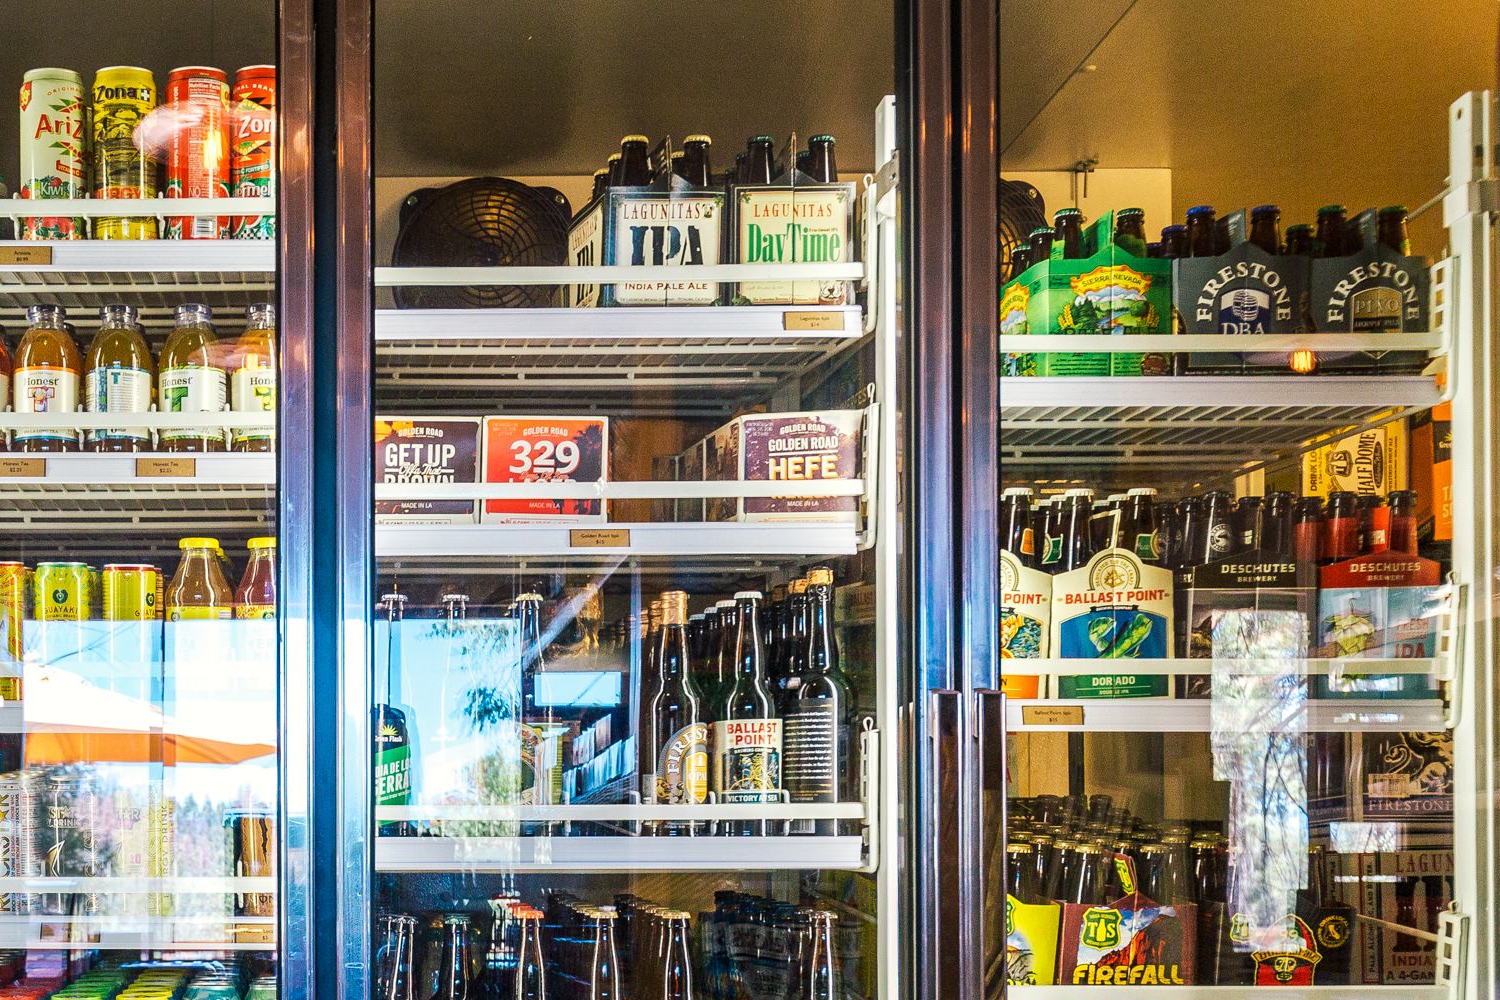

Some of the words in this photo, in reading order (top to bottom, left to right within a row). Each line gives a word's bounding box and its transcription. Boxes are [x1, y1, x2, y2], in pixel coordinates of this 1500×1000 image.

[623, 202, 701, 220] LAGUNITAS
[753, 203, 833, 218] LAGUNITAS
[629, 225, 705, 266] IPA
[747, 222, 841, 264] DayTime
[624, 282, 653, 291] INDIA
[656, 282, 686, 291] PALE
[690, 281, 709, 291] ALE
[1082, 275, 1110, 286] SIERRA
[1112, 273, 1142, 286] NEVADA
[1196, 261, 1292, 323] FIRESTONE
[1327, 261, 1420, 323] FIRESTONE
[1355, 300, 1400, 313] PIVO
[1221, 322, 1266, 335] DBA
[25, 377, 60, 388] Honest
[161, 375, 194, 387] Honest
[398, 427, 425, 437] GOLDEN
[426, 427, 444, 437] ROAD
[523, 427, 549, 437] GOLDEN
[550, 427, 569, 437] ROAD
[780, 424, 806, 435] GOLDEN
[807, 423, 826, 433] ROAD
[768, 437, 809, 452] GOLDEN
[810, 436, 839, 449] ROAD
[1359, 432, 1377, 465] DOME
[385, 443, 423, 467] GET
[432, 444, 456, 467] UP
[509, 440, 581, 474] 329
[769, 455, 840, 481] HEFE
[1357, 465, 1373, 497] HALF
[1221, 563, 1296, 575] DESCHUTES
[1350, 562, 1421, 573] DESCHUTES
[1237, 575, 1277, 583] BREWERY
[1367, 574, 1404, 582] BREWERY
[1003, 593, 1043, 605] POINT
[1065, 592, 1123, 605] BALLAST
[1126, 589, 1166, 602] POINT
[44, 606, 79, 615] GUAYAKI
[1395, 643, 1425, 658] IPA
[1092, 676, 1136, 687] DORADO
[726, 722, 778, 734] BALLAST
[734, 734, 773, 746] POINT
[1368, 799, 1453, 812] FIRESTONE
[1393, 954, 1432, 968] INDIA
[1072, 964, 1185, 985] FIREFALL
